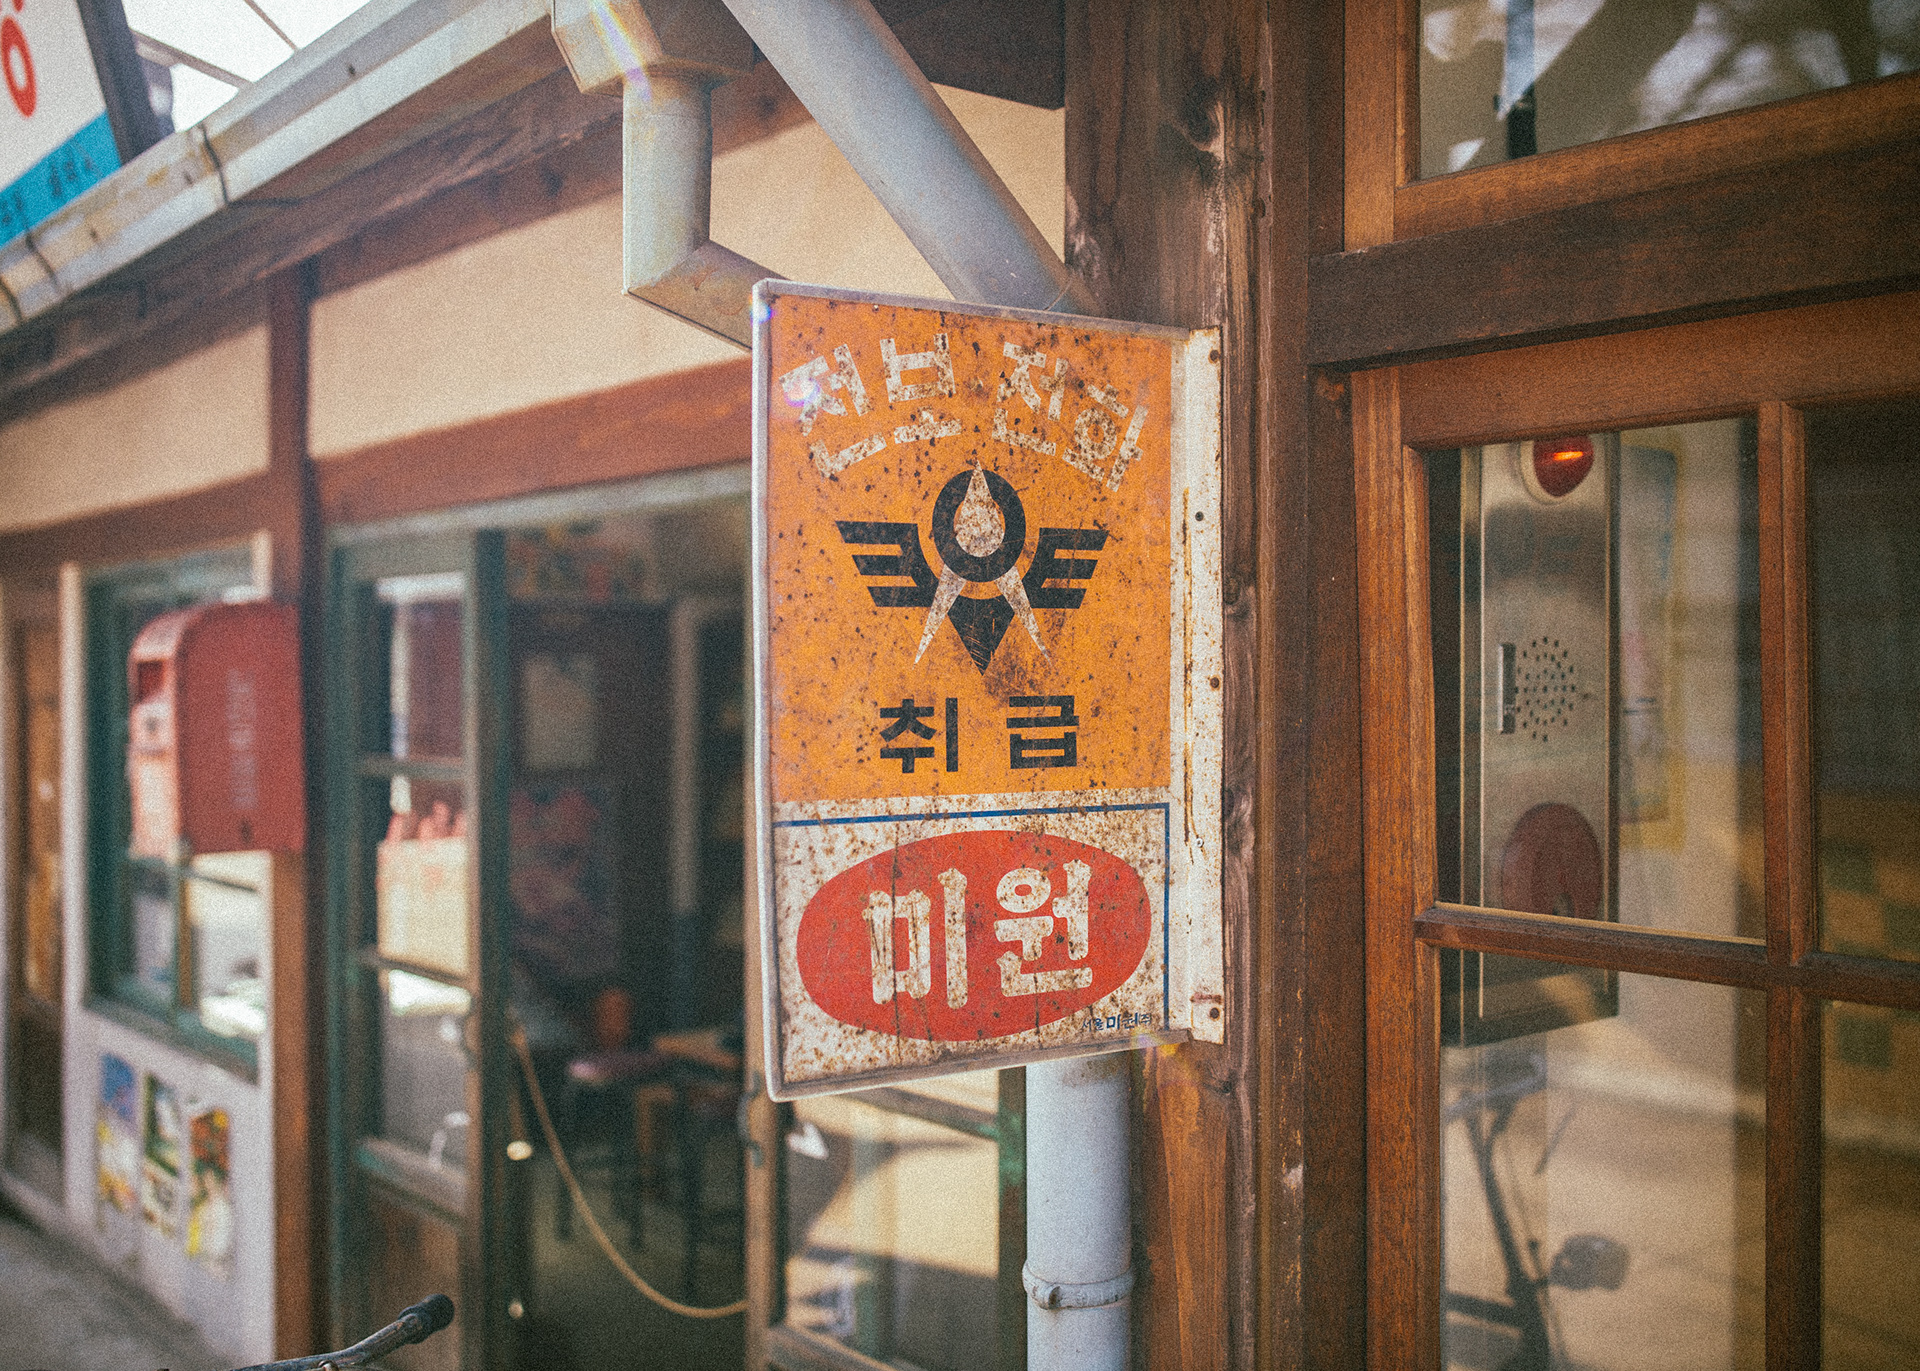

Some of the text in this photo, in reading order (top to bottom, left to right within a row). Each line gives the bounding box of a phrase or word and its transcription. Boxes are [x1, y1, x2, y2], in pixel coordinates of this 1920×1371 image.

[779, 333, 1148, 492] 전보 전화
[880, 695, 1079, 773] 취급
[862, 859, 1093, 1009] 미원
